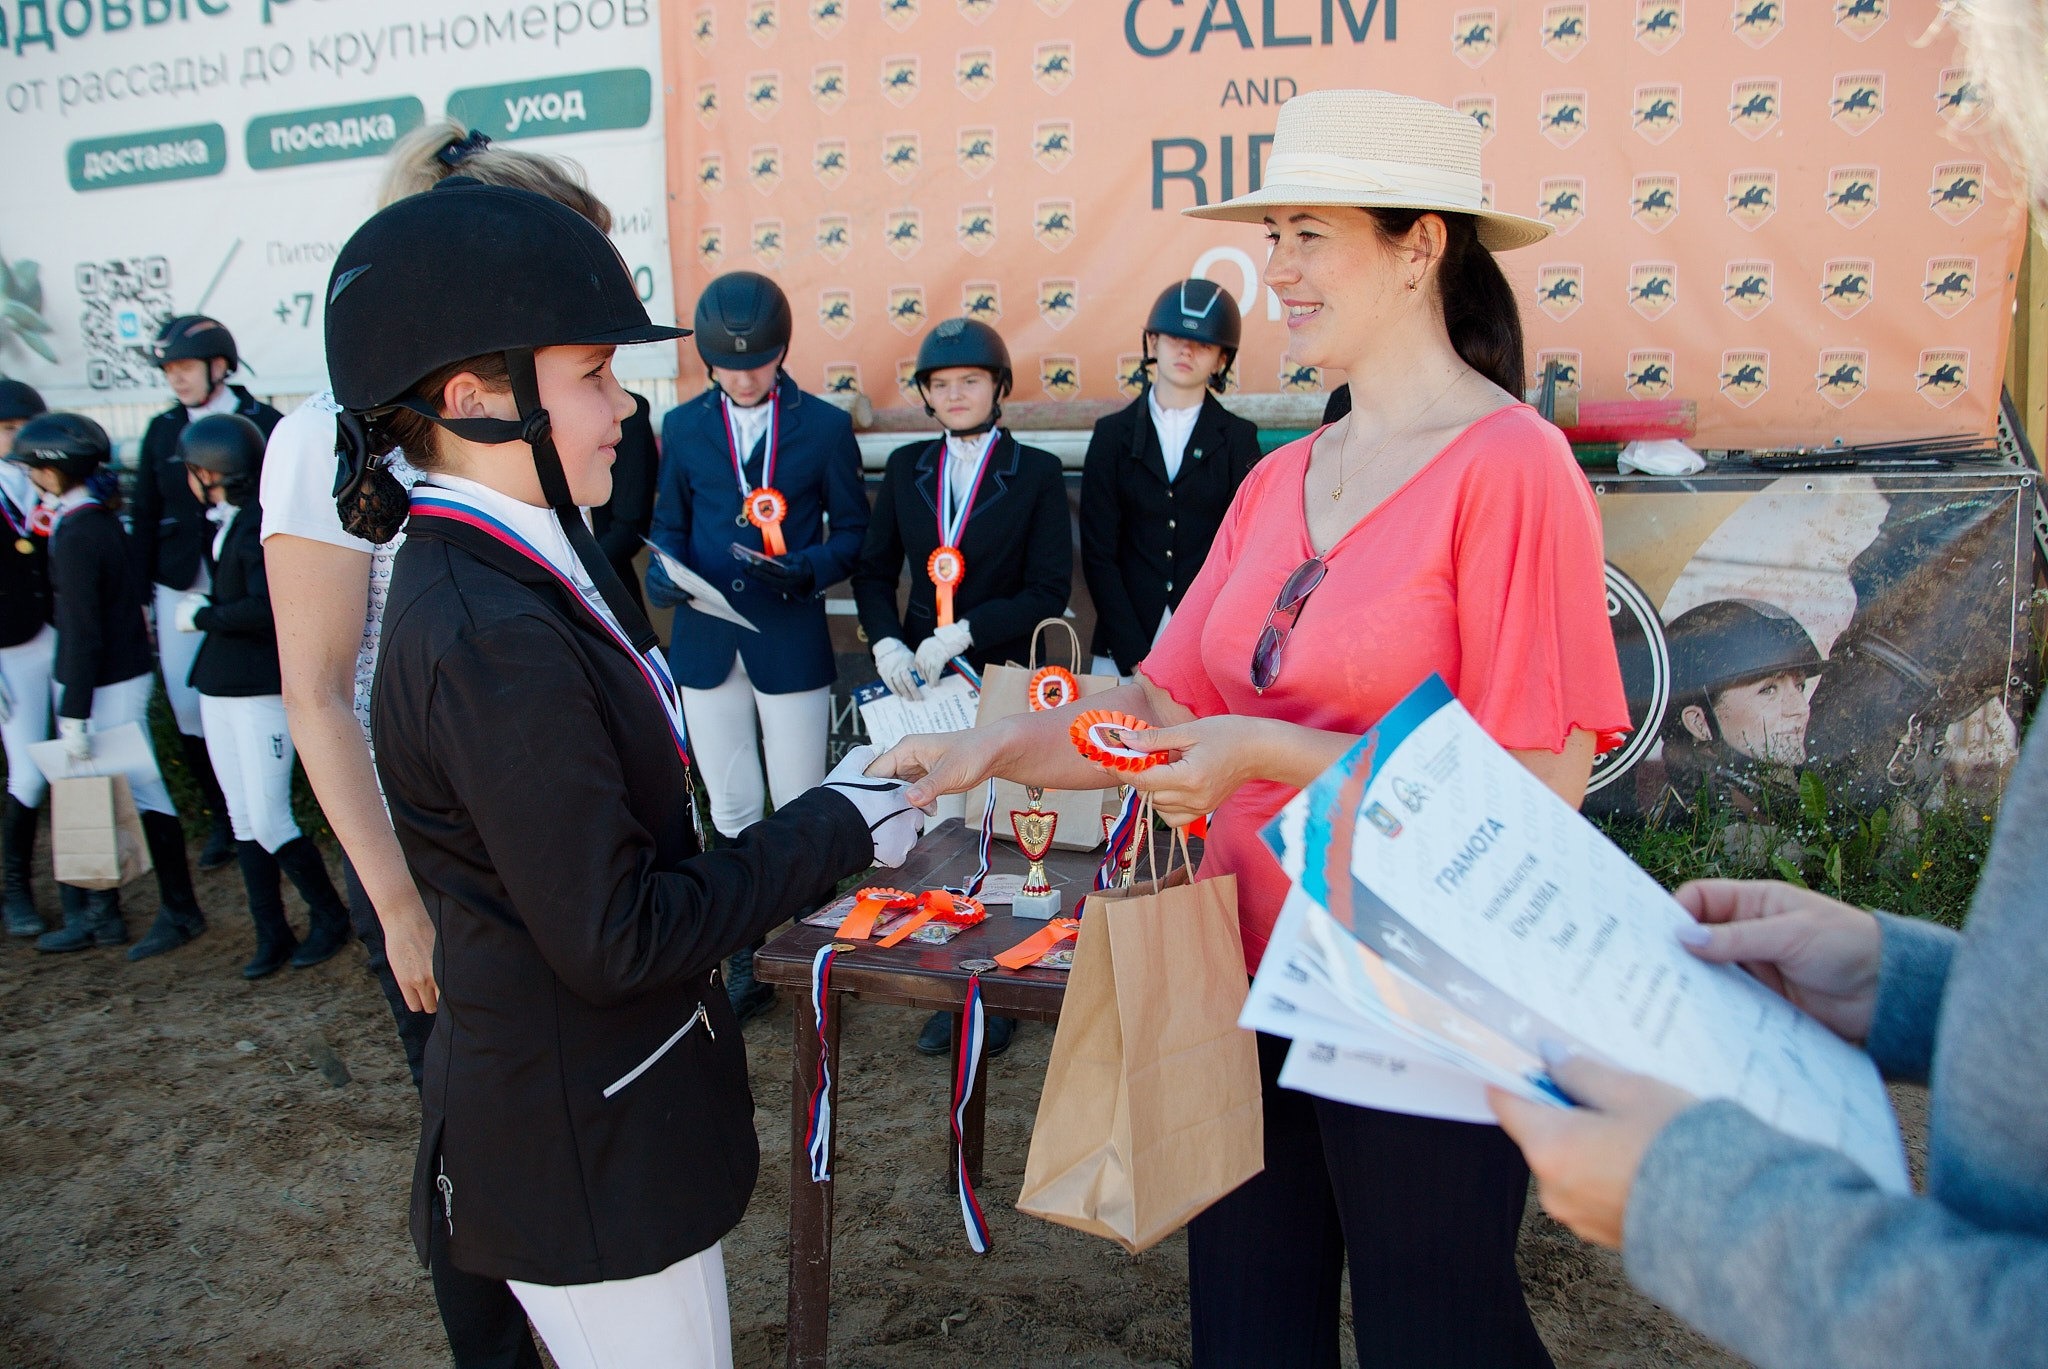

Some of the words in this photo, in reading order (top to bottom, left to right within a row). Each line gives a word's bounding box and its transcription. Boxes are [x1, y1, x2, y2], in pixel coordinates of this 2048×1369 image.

[1123, 0, 1398, 58] CALM
[5, 78, 47, 113] от
[57, 52, 229, 117] рассады
[240, 42, 295, 87] до
[308, 0, 650, 78] крупномеров
[504, 89, 587, 133] уход
[1220, 77, 1297, 107] AND
[269, 114, 397, 154] посадка
[82, 138, 210, 180] доставка
[273, 292, 315, 328] +7
[1434, 816, 1506, 896] ГРАМОТА
